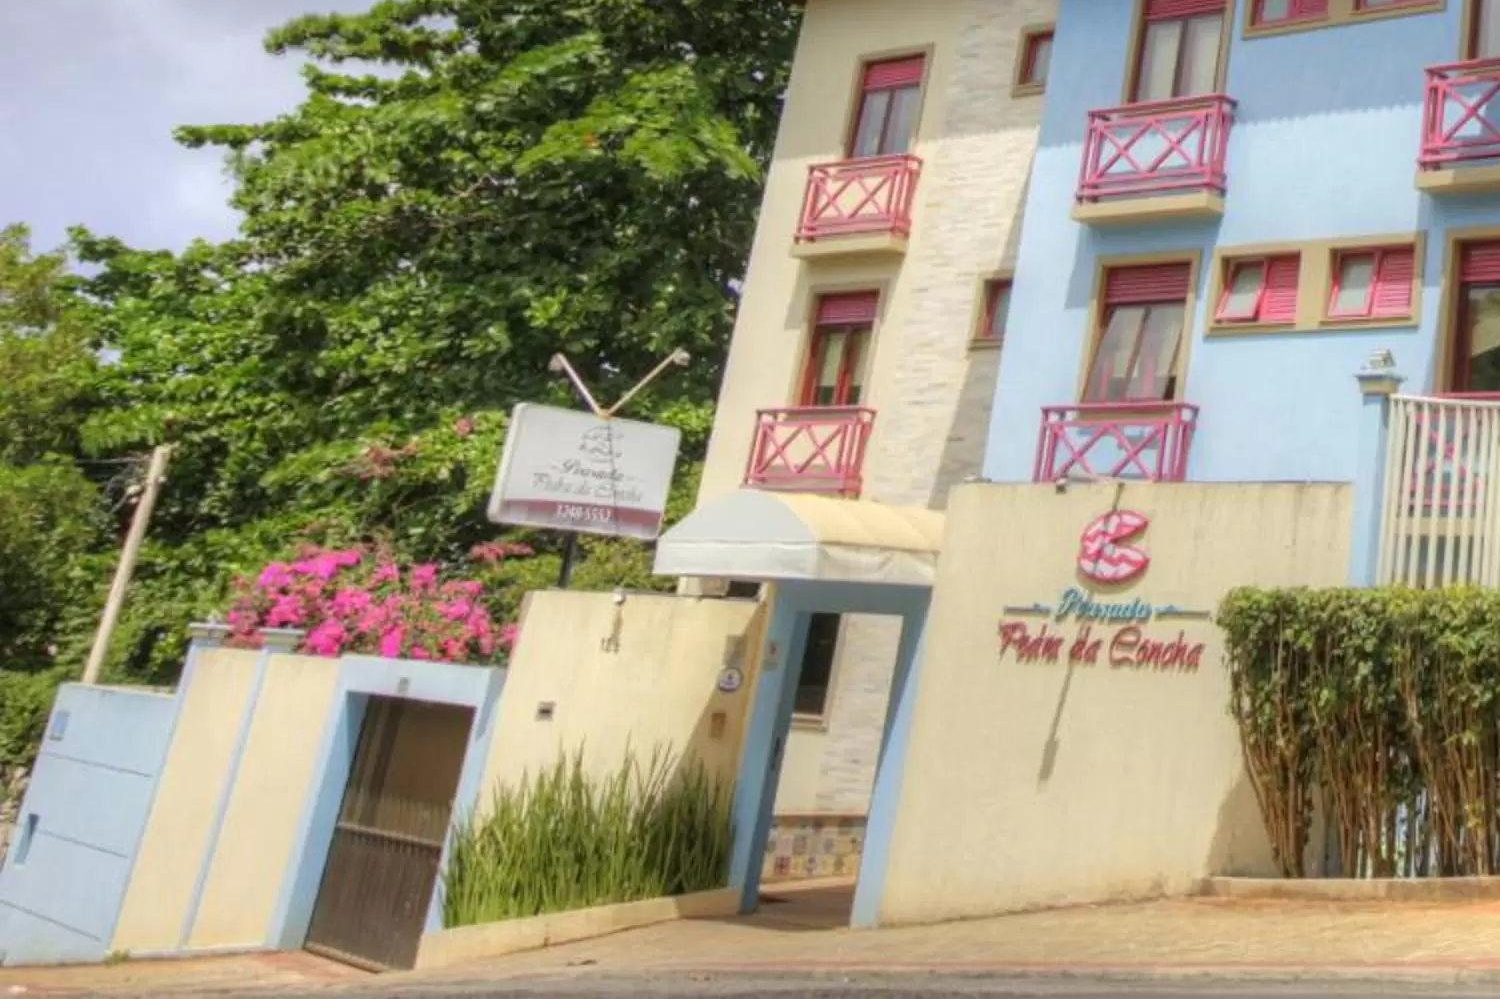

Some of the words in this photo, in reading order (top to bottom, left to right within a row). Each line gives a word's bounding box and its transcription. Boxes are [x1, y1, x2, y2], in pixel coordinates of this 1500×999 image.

[1055, 587, 1152, 621] Pousada
[998, 620, 1064, 663] Pedra
[1070, 624, 1102, 665] da
[1109, 624, 1205, 670] Concha
